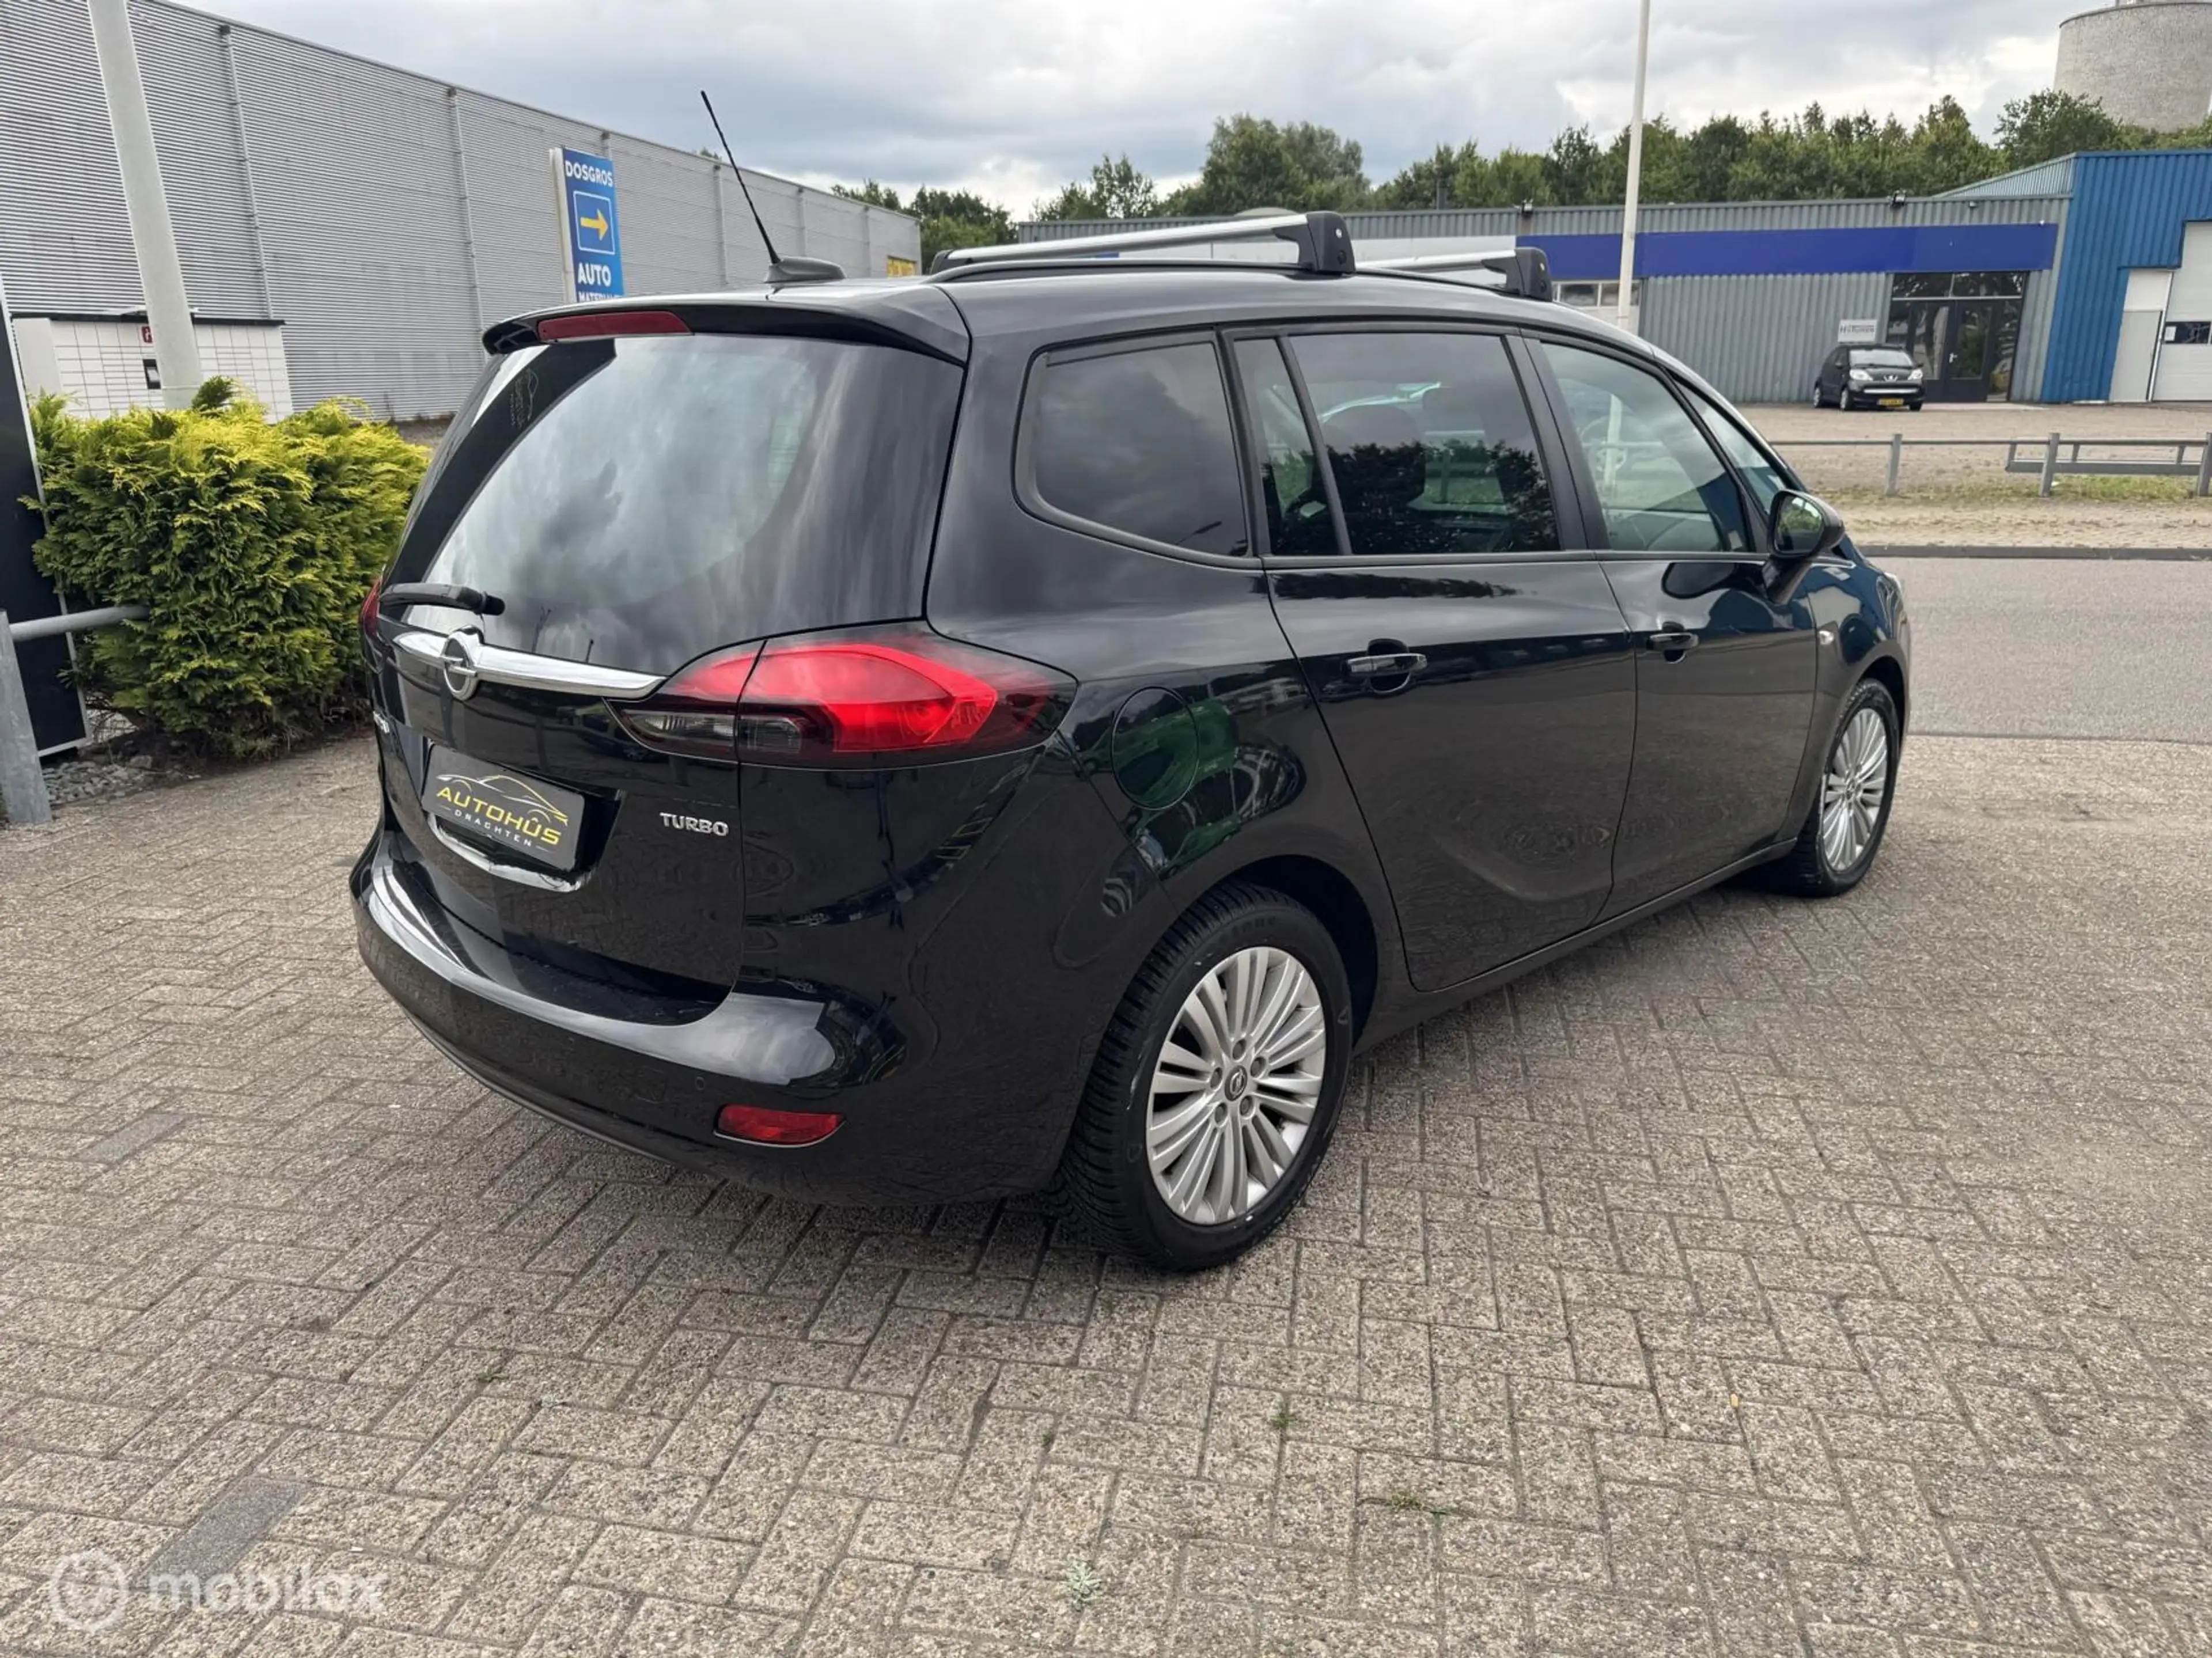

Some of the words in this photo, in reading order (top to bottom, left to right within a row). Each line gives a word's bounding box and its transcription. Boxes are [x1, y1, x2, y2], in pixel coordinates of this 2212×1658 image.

[565, 160, 613, 187] DOSGROS
[578, 261, 612, 287] AUTO
[436, 787, 562, 845] AUTOHÛS
[454, 809, 532, 847] DRACHTEN
[660, 812, 729, 836] TURBO
